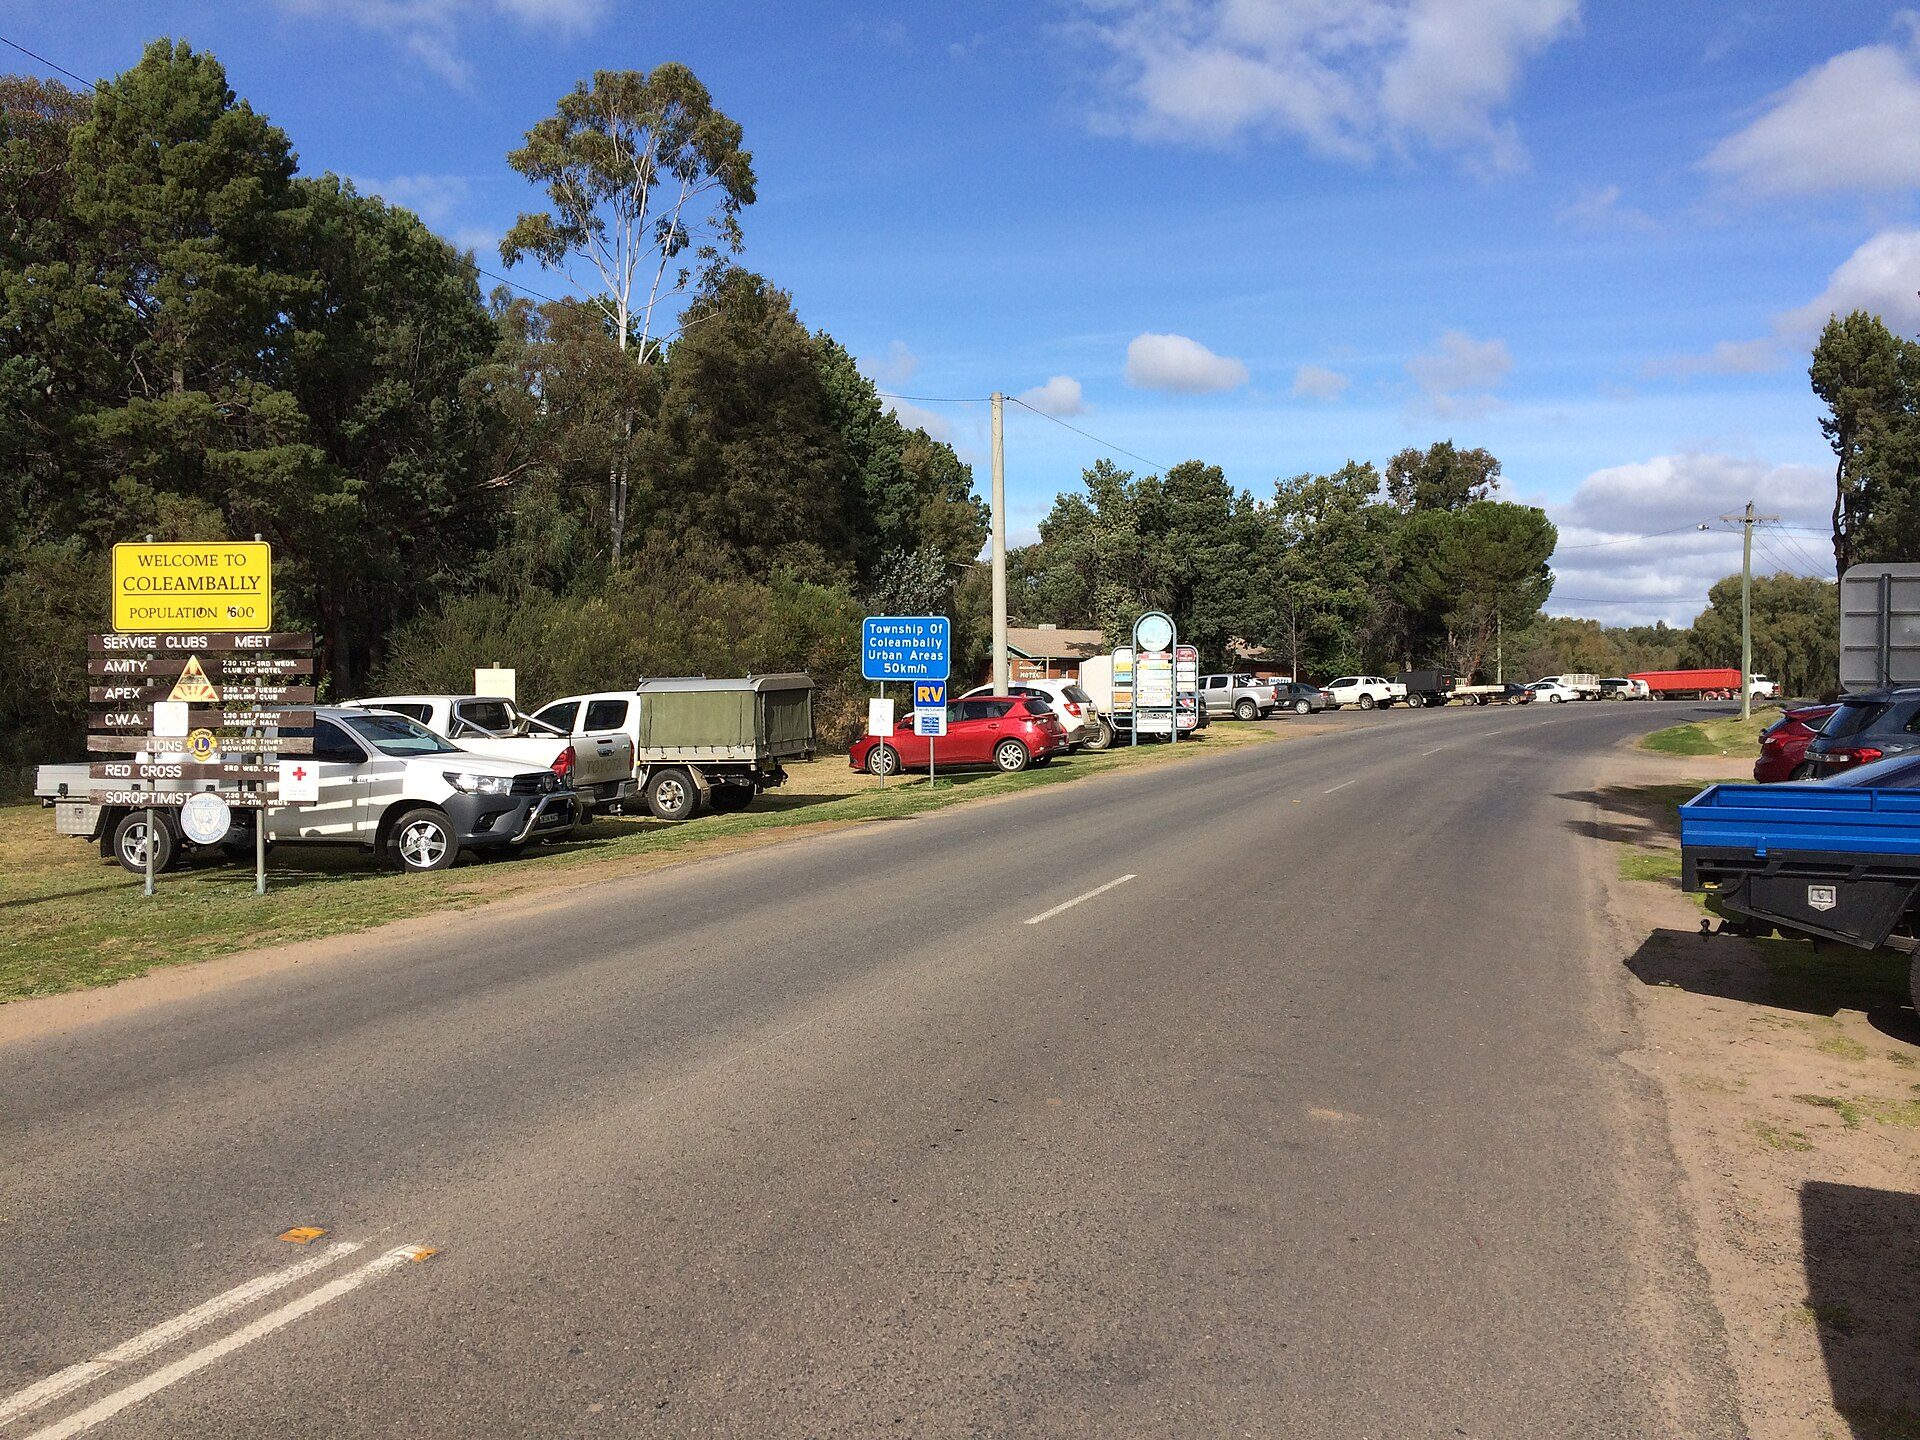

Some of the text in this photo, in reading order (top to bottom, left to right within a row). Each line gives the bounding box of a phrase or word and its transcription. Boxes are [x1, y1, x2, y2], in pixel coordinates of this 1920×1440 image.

[138, 554, 247, 567] WELCOME TO
[123, 576, 261, 591] COLEAMBALLY
[129, 606, 218, 619] POPULATION
[869, 623, 943, 636] Township Of
[103, 635, 271, 649] SERVICE CLUBS MEET
[869, 637, 942, 649] Coleambally
[868, 650, 944, 661] Urban Areas
[103, 660, 146, 673] AMITY
[883, 663, 928, 674] 50km/h
[105, 687, 140, 699] APEX
[917, 686, 944, 702] RV
[105, 713, 144, 726] C.W.A.
[146, 740, 183, 752] LIONS
[197, 738, 207, 750] L
[105, 764, 182, 778] RED CROSS
[106, 791, 192, 805] SOROPTIMIST
